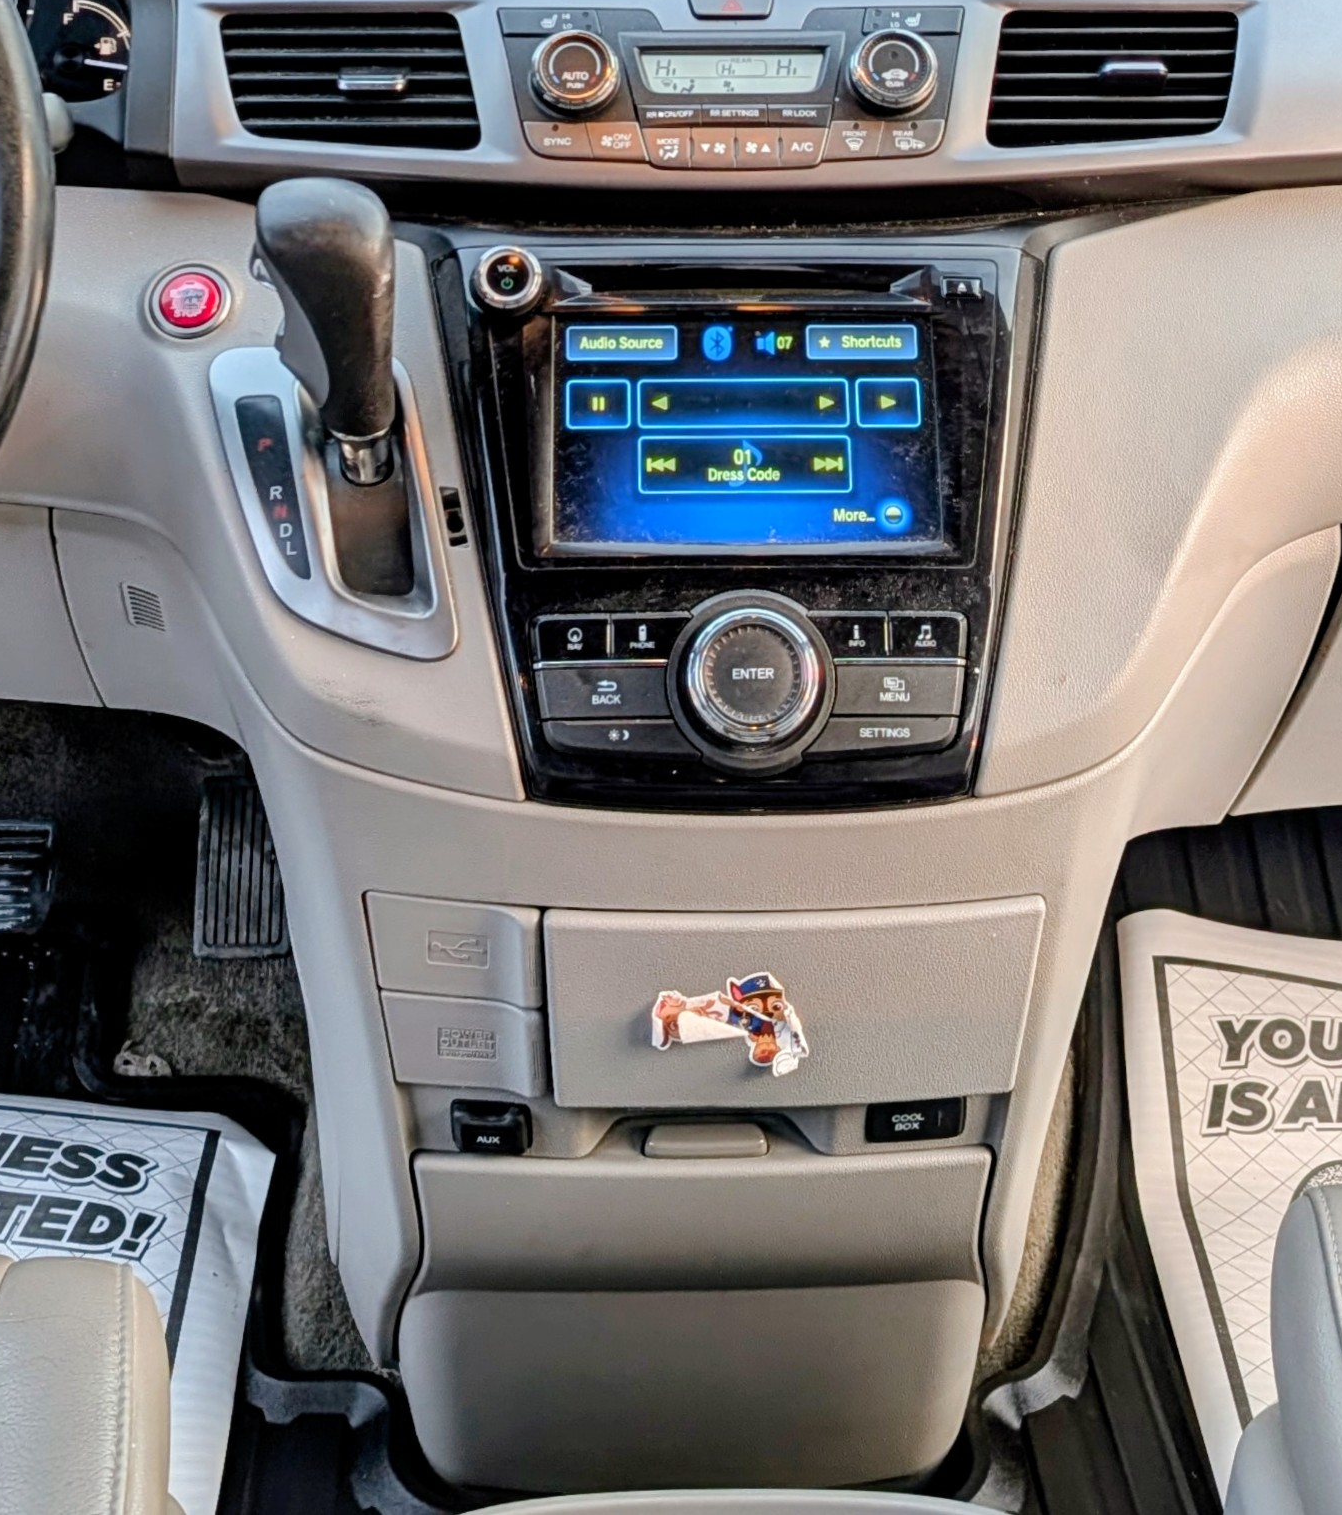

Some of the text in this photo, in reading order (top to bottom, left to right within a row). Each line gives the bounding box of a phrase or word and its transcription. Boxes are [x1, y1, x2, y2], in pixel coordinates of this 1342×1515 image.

[63, 12, 74, 25] F
[561, 71, 589, 81] AUTO
[103, 78, 115, 91] E
[664, 110, 694, 118] ON/OFF
[710, 109, 759, 117] RR SETTINGS
[782, 109, 817, 118] RR LOCK
[543, 137, 572, 147] SYNC
[612, 141, 632, 149] OFF
[656, 137, 680, 145] MODE
[790, 141, 814, 152] A/C
[496, 264, 518, 273] VOL
[579, 335, 664, 351] Audio Source
[776, 335, 793, 351] 07
[841, 334, 903, 350] Shortcuts
[258, 437, 272, 452] P
[733, 448, 752, 466] 01
[707, 467, 780, 482] Dress Code
[269, 485, 284, 501] R
[273, 504, 287, 519] N
[833, 508, 876, 523] More...
[279, 522, 294, 538] D
[285, 540, 297, 556] L
[629, 640, 656, 649] PHONE
[848, 639, 866, 647] INFO
[914, 639, 937, 647] AUDIO
[731, 667, 775, 680] ENTER
[591, 694, 622, 706] BACK
[879, 690, 911, 702] MENU
[859, 727, 911, 739] SETTINGS
[1203, 1079, 1274, 1136] IS
[891, 1112, 925, 1124] COOL
[894, 1122, 921, 1132] BOX
[475, 1135, 500, 1145] AUX
